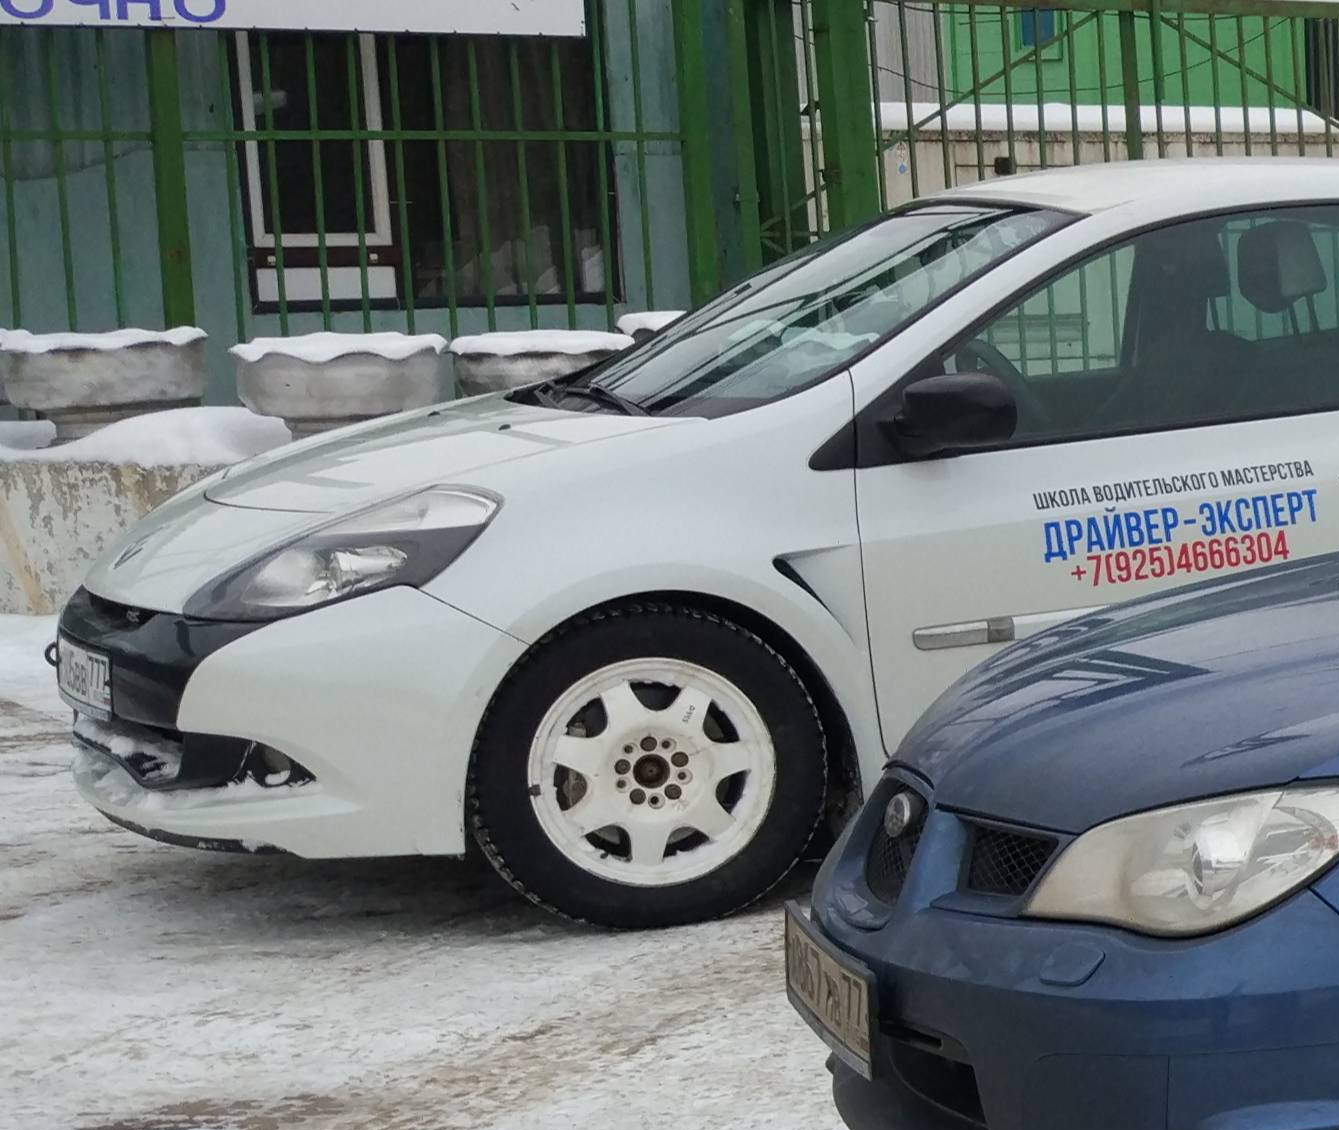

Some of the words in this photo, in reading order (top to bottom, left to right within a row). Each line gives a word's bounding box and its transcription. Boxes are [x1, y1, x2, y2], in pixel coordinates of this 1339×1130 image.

[1033, 487, 1091, 510] ШКОЛА
[1093, 471, 1219, 503] ВОДИТЕЛЬСКОГО
[1222, 460, 1314, 488] МАСТЕРСТВА
[1071, 530, 1290, 586] +7(925)4666304
